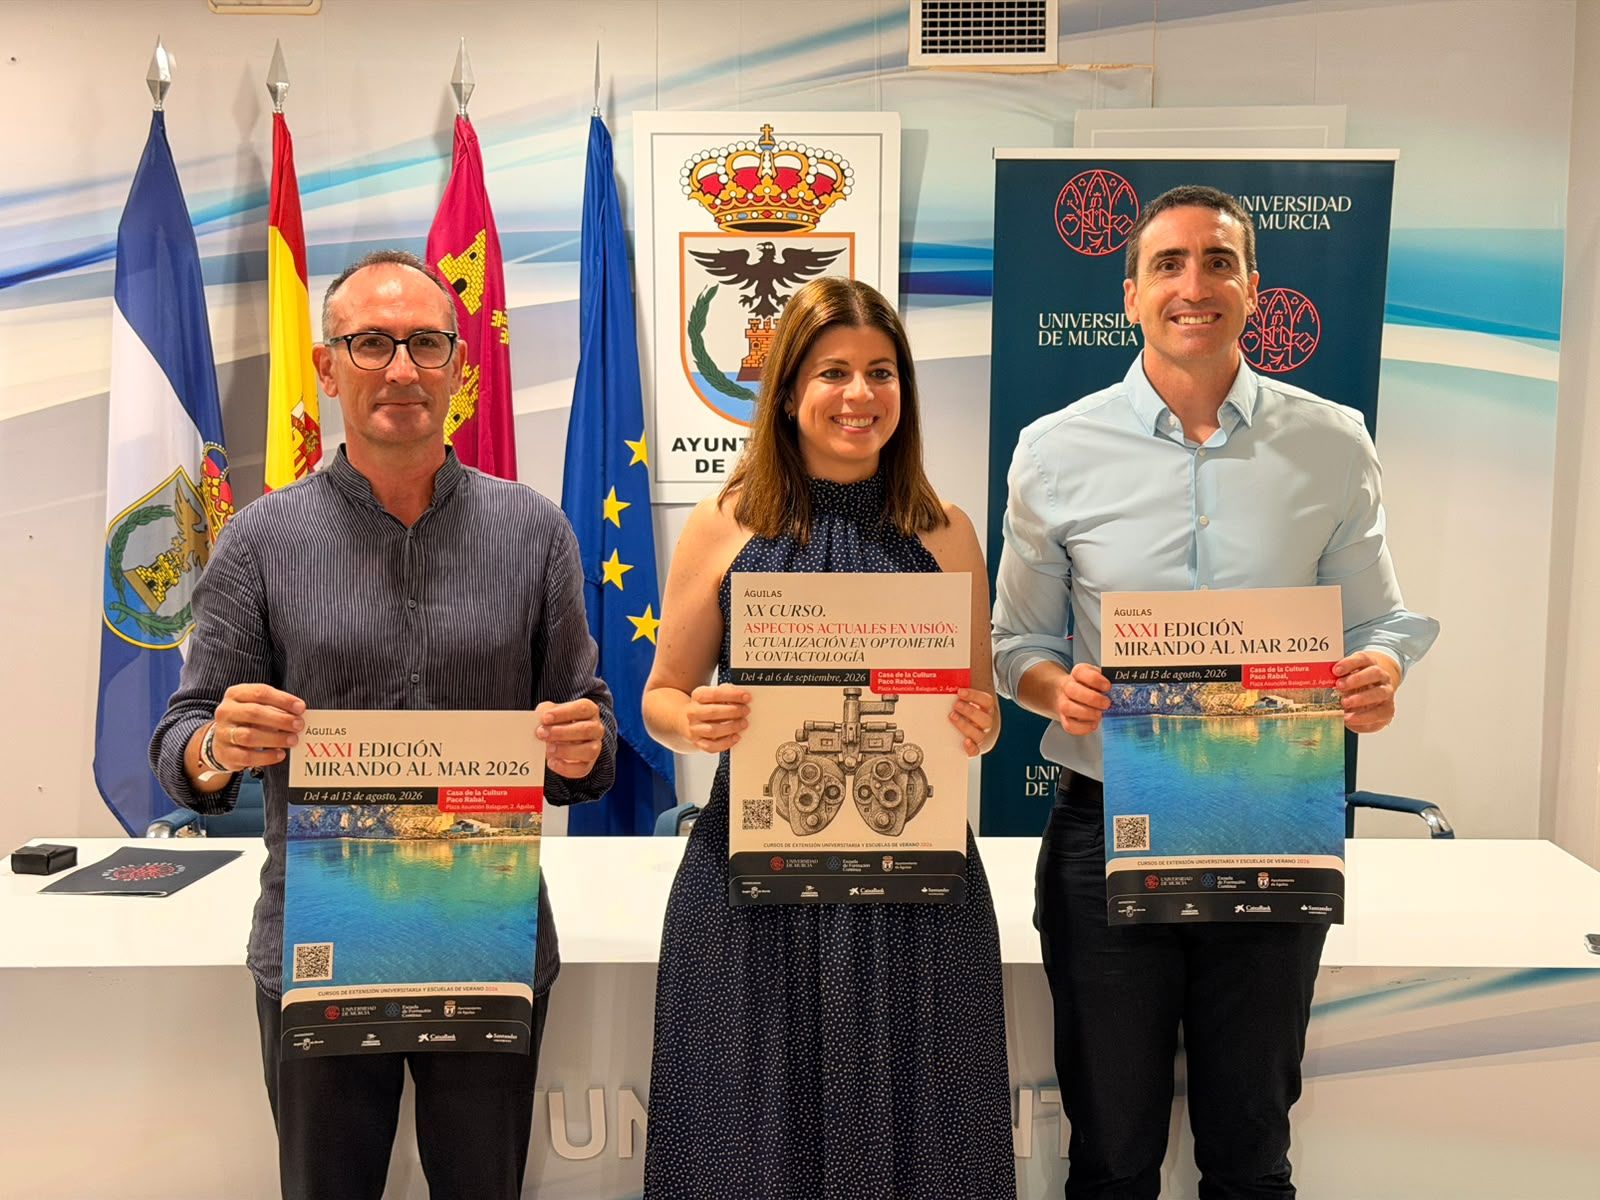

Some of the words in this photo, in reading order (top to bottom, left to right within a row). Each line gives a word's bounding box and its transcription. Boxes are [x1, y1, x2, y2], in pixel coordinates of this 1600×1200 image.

[1258, 214, 1331, 230] MURCIA
[1039, 313, 1135, 329] UNIVERSID
[1038, 331, 1063, 347] DE
[1068, 331, 1139, 347] MURCIA
[695, 459, 725, 474] DE
[744, 589, 782, 598] ÁGUILAS
[743, 604, 765, 618] XX
[769, 604, 827, 618] CURSO.
[1114, 608, 1152, 617] ÁGUILAS
[744, 623, 814, 634] ASPECTOS
[817, 623, 887, 634] ACTUALES
[889, 623, 908, 634] EN
[910, 621, 958, 634] VISIÓN:
[1114, 623, 1159, 638] XXXI
[1164, 619, 1244, 637] EDICIÓN
[743, 636, 850, 648] ACTUALIZACIÓN
[850, 637, 867, 648] EN
[870, 636, 956, 648] OPTOMETRÍA
[1114, 640, 1205, 657] MIRANDO
[1210, 640, 1235, 655] AL
[1239, 639, 1282, 654] MAR
[1286, 636, 1330, 653] 2026
[744, 651, 752, 662] Y
[755, 650, 865, 662] CONTACTOLOGÍA
[740, 673, 755, 681] Del
[757, 673, 763, 681] 4
[765, 673, 774, 681] al
[775, 673, 782, 681] 6
[783, 673, 794, 681] de
[795, 672, 842, 684] septiembre,
[843, 673, 866, 681] 2026
[1115, 670, 1130, 680] Del
[1131, 670, 1138, 680] 4
[1140, 670, 1148, 680] al
[1150, 670, 1159, 680] 13
[1161, 670, 1171, 680] de
[1172, 670, 1202, 681] agosto,
[1204, 669, 1227, 679] 2026
[305, 726, 347, 736] ÁGUILAS
[305, 742, 352, 758] XXXI
[358, 739, 443, 758] EDICIÓN
[304, 761, 401, 777] MIRANDO
[406, 761, 432, 777] AL
[437, 761, 481, 777] MAR
[485, 760, 530, 776] 2026
[1025, 782, 1049, 797] DE
[303, 791, 320, 801] Del
[321, 791, 329, 801] 4
[330, 791, 339, 801] al
[341, 791, 352, 801] 13
[353, 791, 364, 801] de
[365, 791, 397, 803] agosto,
[399, 791, 423, 801] 2026
[446, 796, 463, 804] Paco
[464, 796, 486, 804] Rabal,
